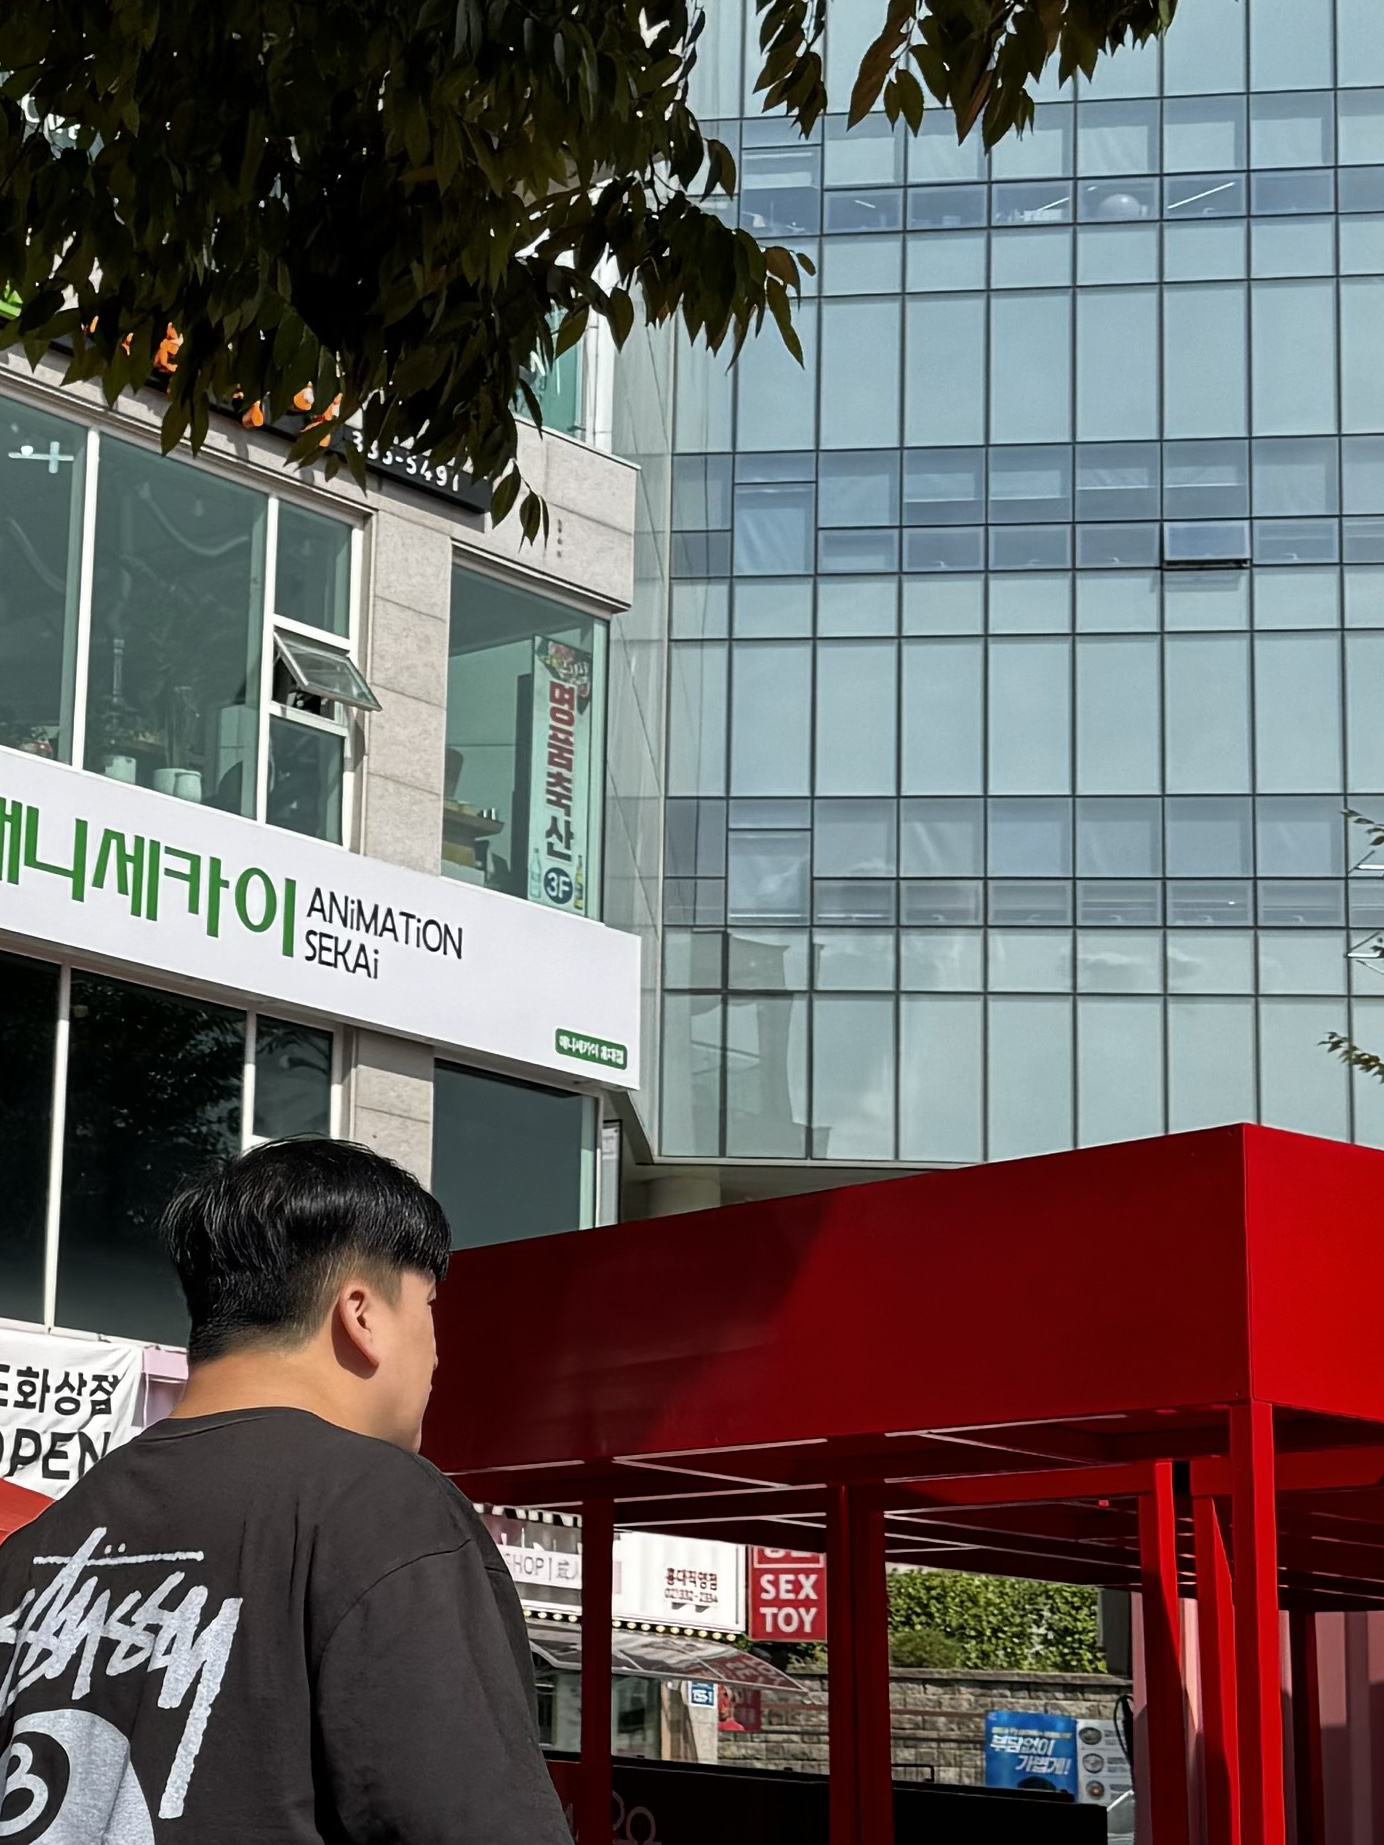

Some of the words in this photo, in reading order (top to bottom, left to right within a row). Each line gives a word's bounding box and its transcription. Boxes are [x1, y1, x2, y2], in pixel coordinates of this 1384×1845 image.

[546, 872, 573, 898] 3F
[760, 1573, 819, 1600] SEX
[759, 1606, 818, 1633] TOY
[990, 1734, 1056, 1757] 부담없이
[1015, 1755, 1072, 1775] 가볍게!
